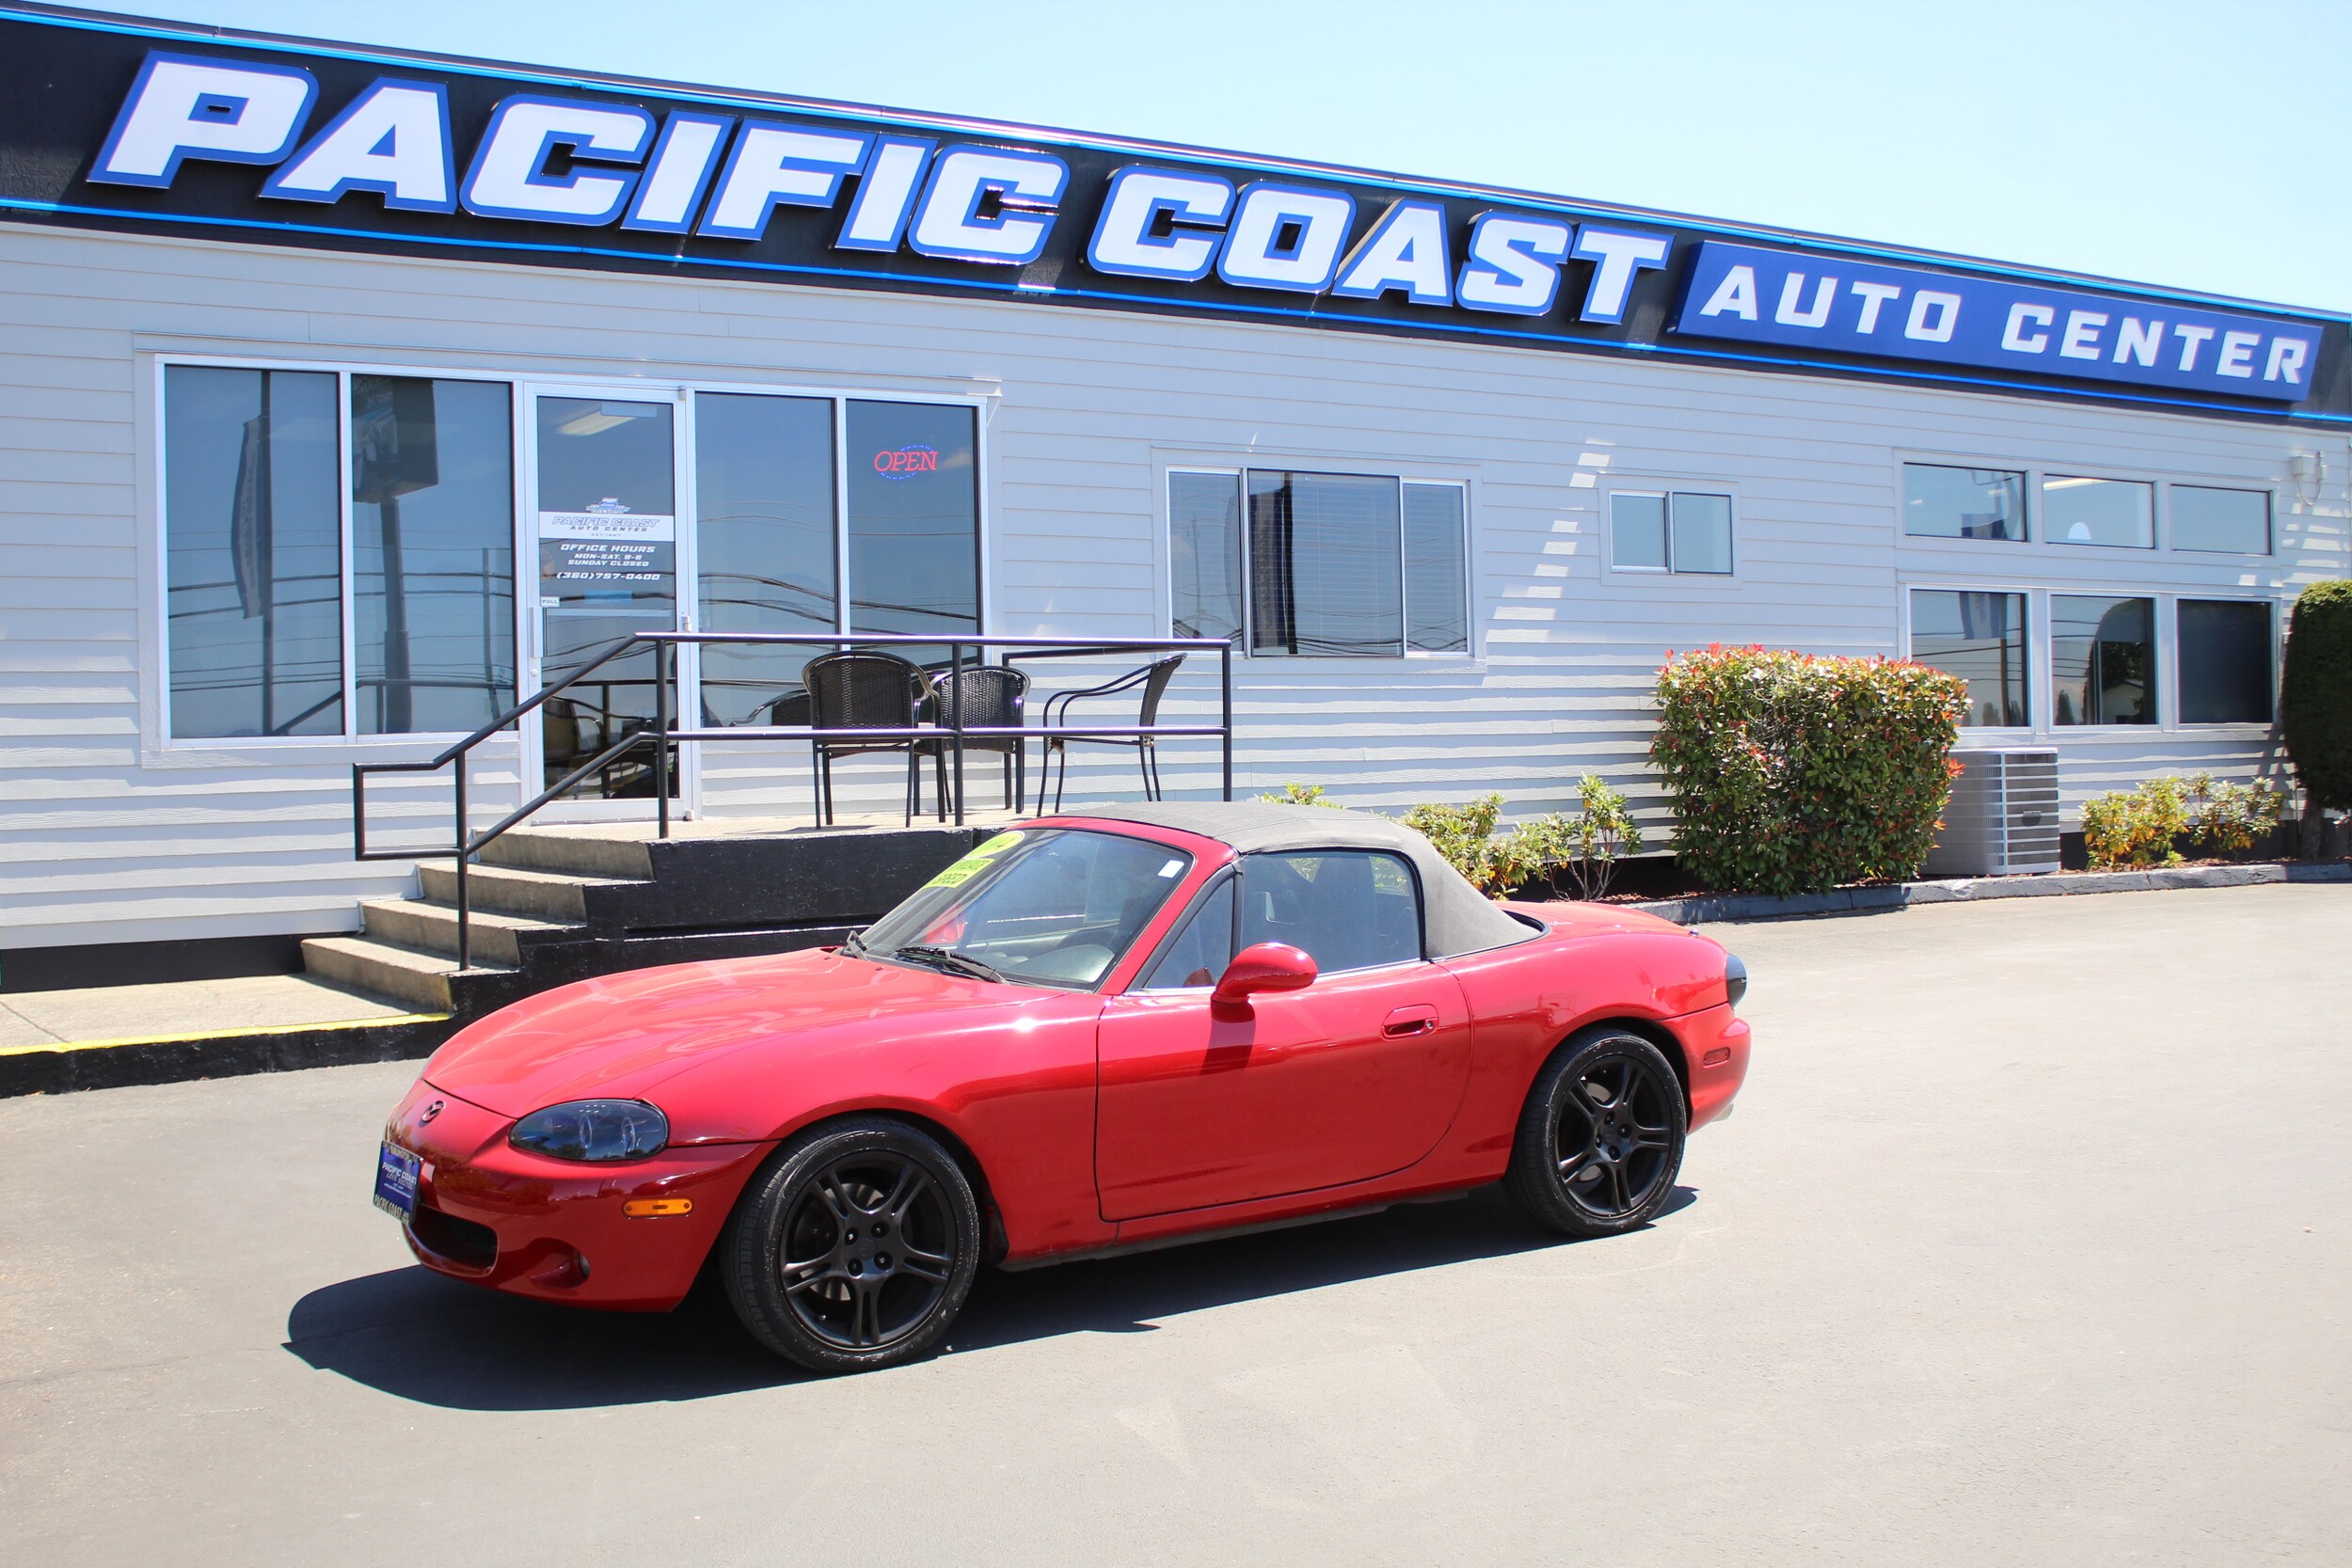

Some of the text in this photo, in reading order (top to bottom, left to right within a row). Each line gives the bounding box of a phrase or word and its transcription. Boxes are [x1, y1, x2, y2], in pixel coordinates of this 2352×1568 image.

[87, 49, 1676, 325] PACIFIC COAST
[1698, 264, 2308, 385] AUTO CENTER
[874, 451, 939, 472] OPEN
[552, 516, 660, 528] PACIFIC COAST
[561, 544, 656, 553] OFFICE HOURS
